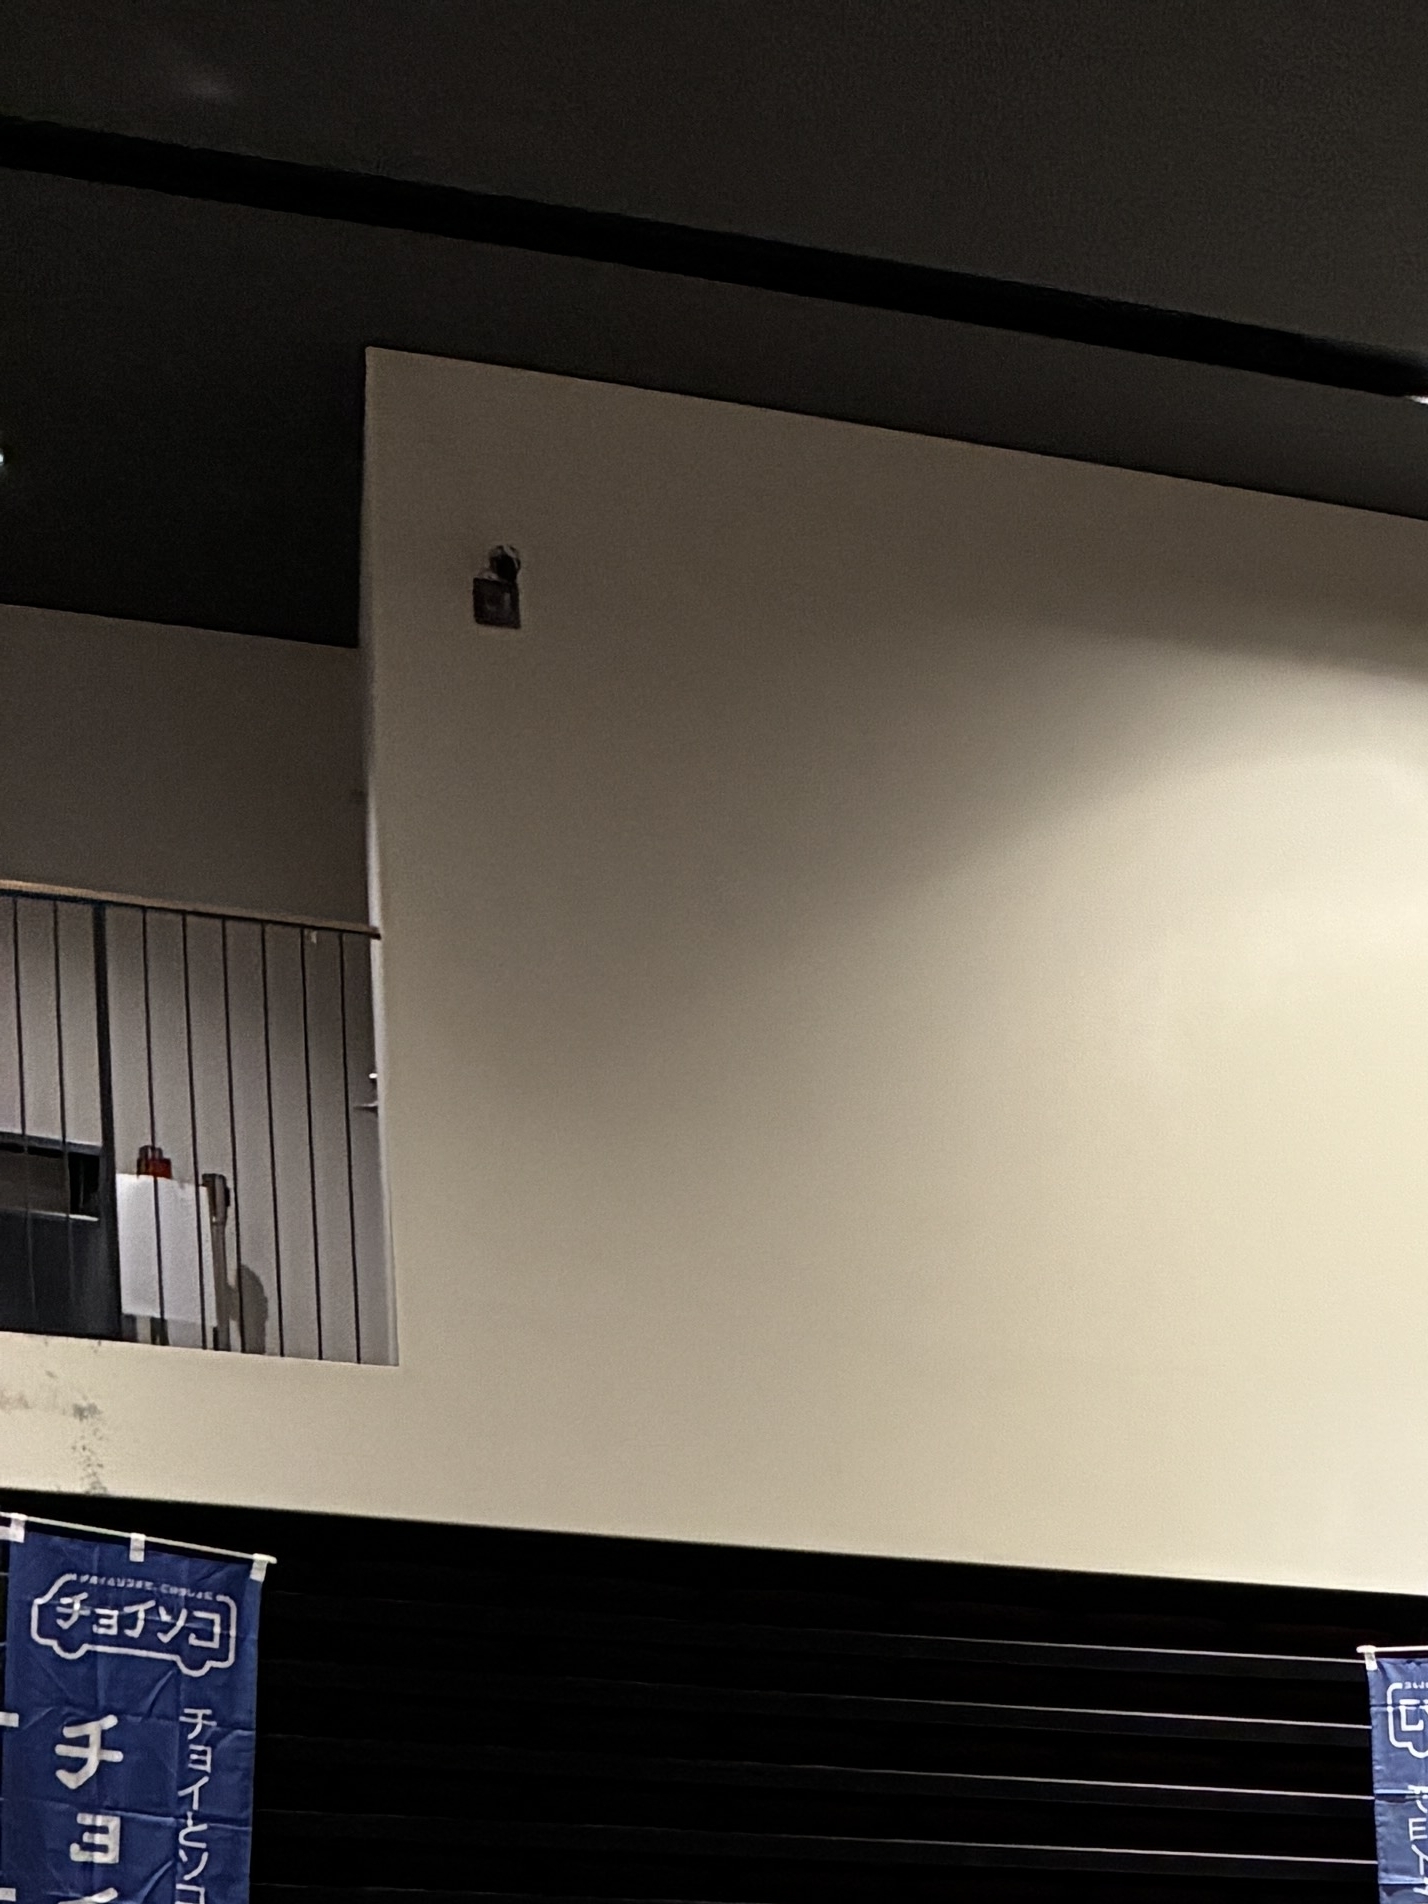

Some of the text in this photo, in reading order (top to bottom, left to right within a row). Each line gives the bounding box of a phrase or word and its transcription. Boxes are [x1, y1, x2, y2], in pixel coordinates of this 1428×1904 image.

[55, 1592, 221, 1649] チョイソコ
